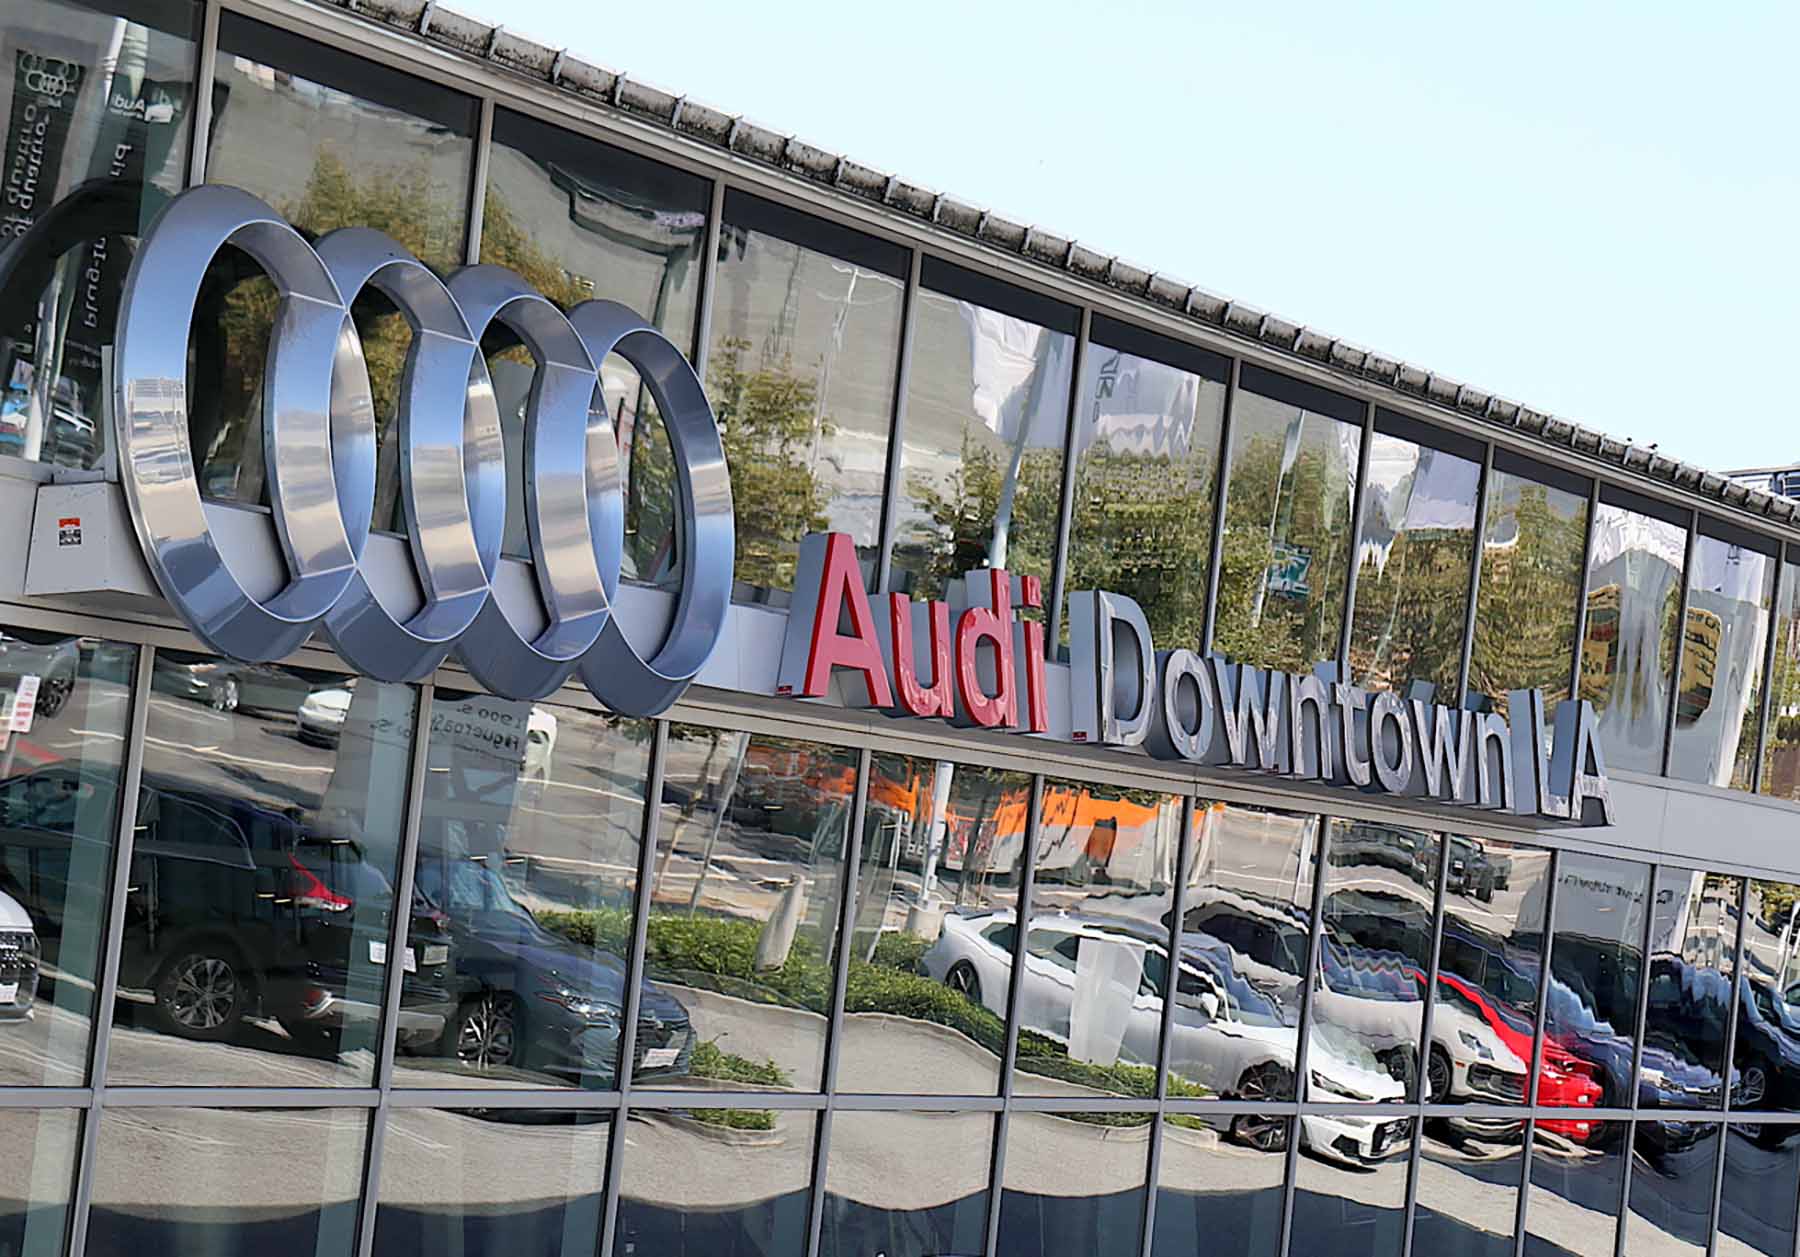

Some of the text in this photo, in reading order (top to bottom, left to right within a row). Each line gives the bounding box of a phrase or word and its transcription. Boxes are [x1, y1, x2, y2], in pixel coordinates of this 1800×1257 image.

[795, 532, 1617, 826] Audi Downtown LA
